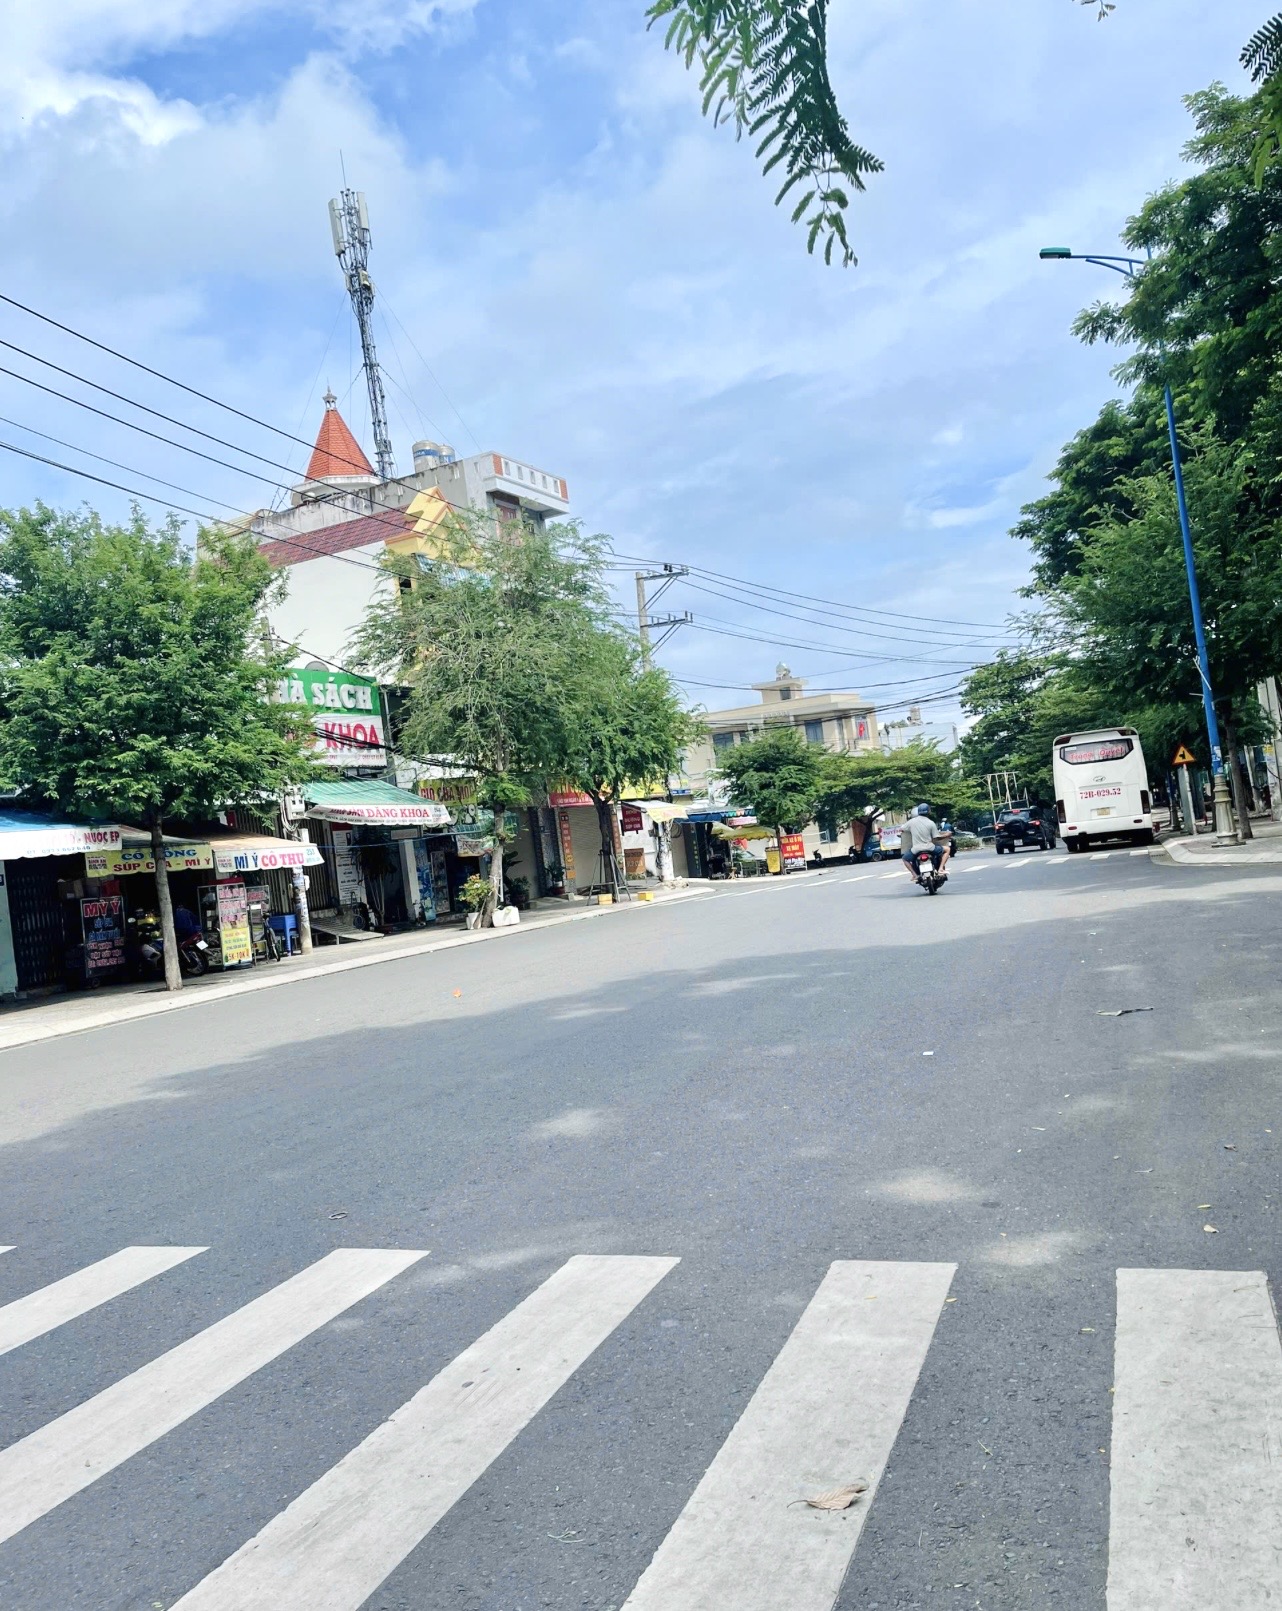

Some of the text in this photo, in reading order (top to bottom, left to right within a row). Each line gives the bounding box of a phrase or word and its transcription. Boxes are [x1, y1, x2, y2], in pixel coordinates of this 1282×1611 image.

[311, 676, 372, 710] SÁCH
[324, 722, 380, 750] KHOA
[1080, 787, 1121, 799] 72B-029.52
[366, 807, 399, 818] ĐĂNG
[400, 808, 430, 818] KHOA
[113, 861, 141, 872] SÚP
[145, 861, 172, 870] CA
[234, 853, 249, 870] MÌ
[251, 852, 259, 868] Ý
[261, 850, 278, 867] CÔ
[279, 852, 305, 866] THU
